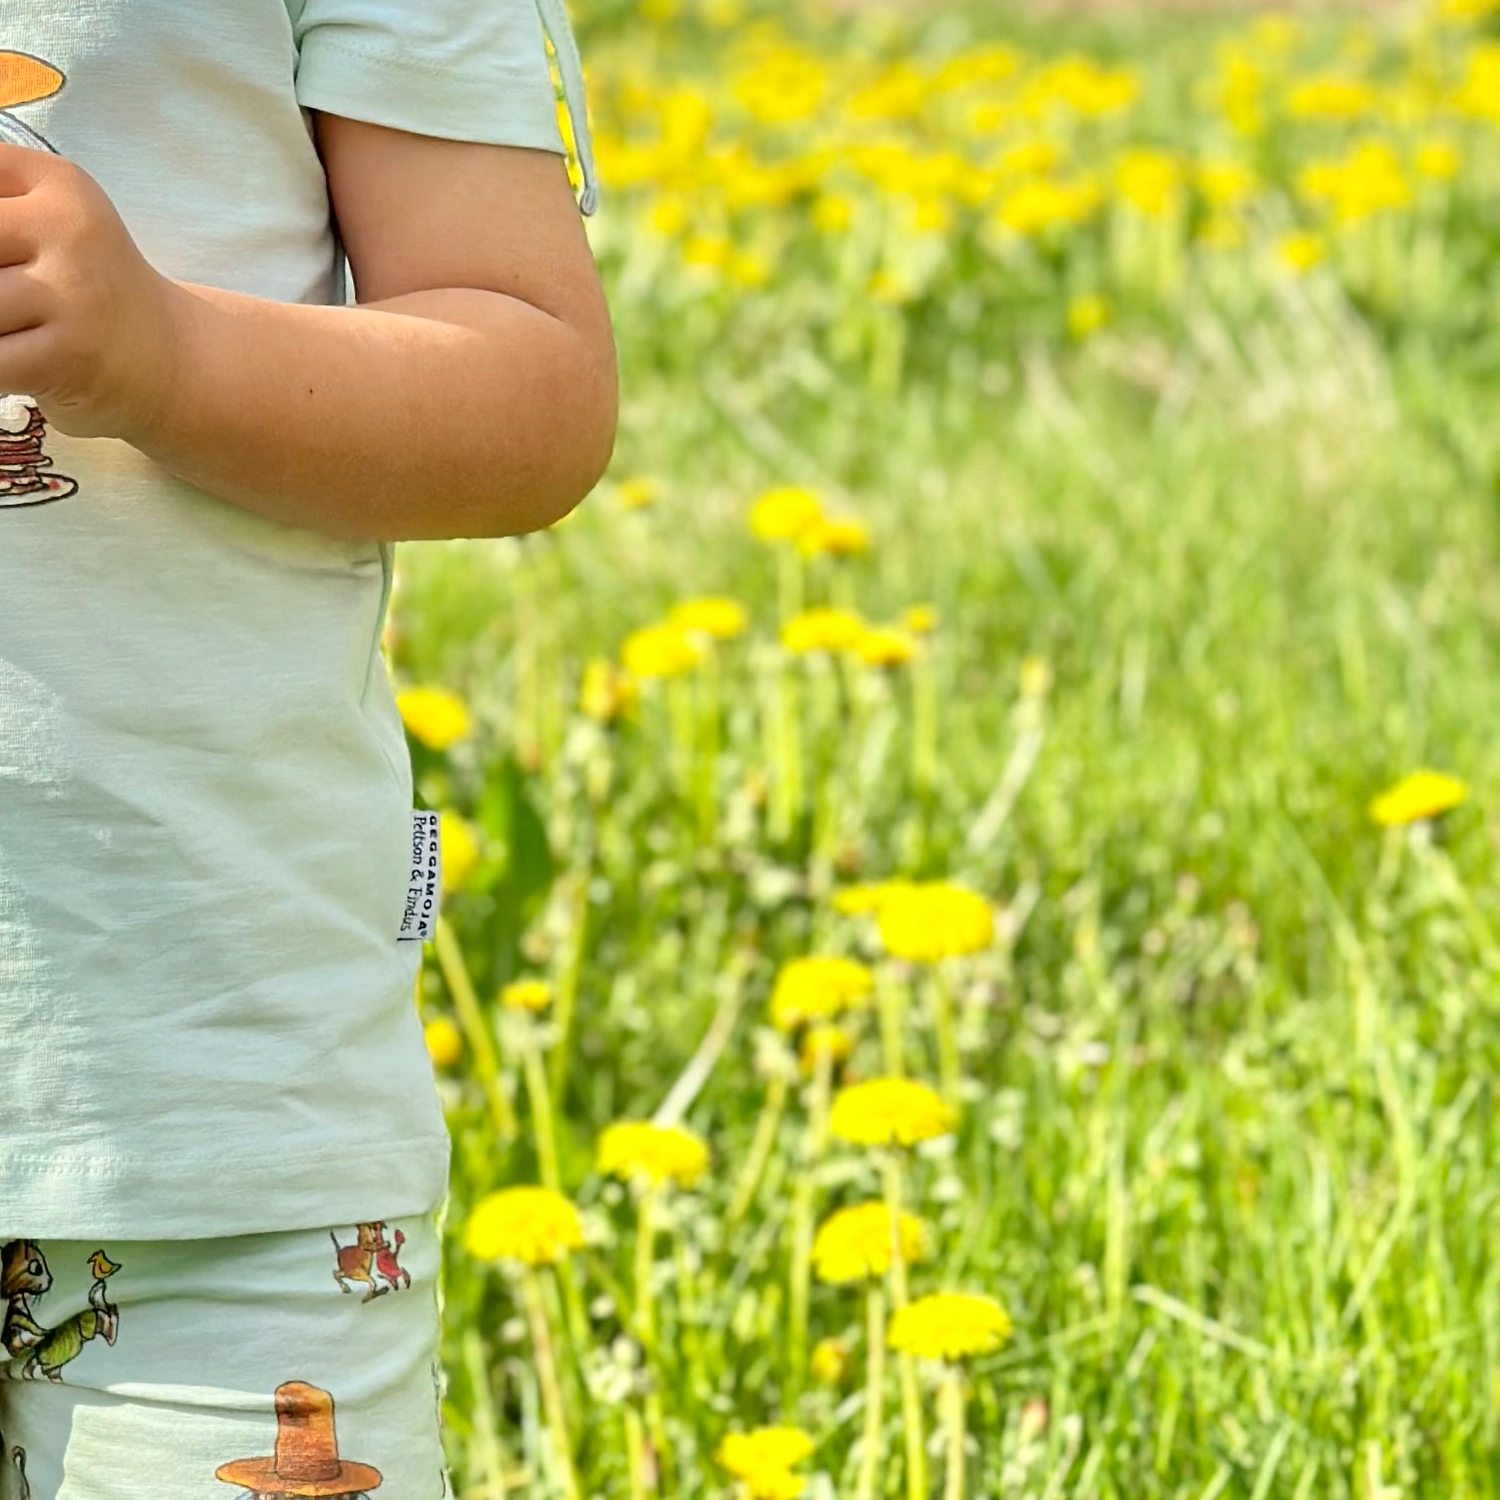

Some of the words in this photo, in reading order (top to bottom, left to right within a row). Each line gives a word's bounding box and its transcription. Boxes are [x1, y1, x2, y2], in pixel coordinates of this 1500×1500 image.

[412, 815, 427, 865] Pettson
[410, 869, 424, 882] &
[400, 887, 422, 931] Findus
